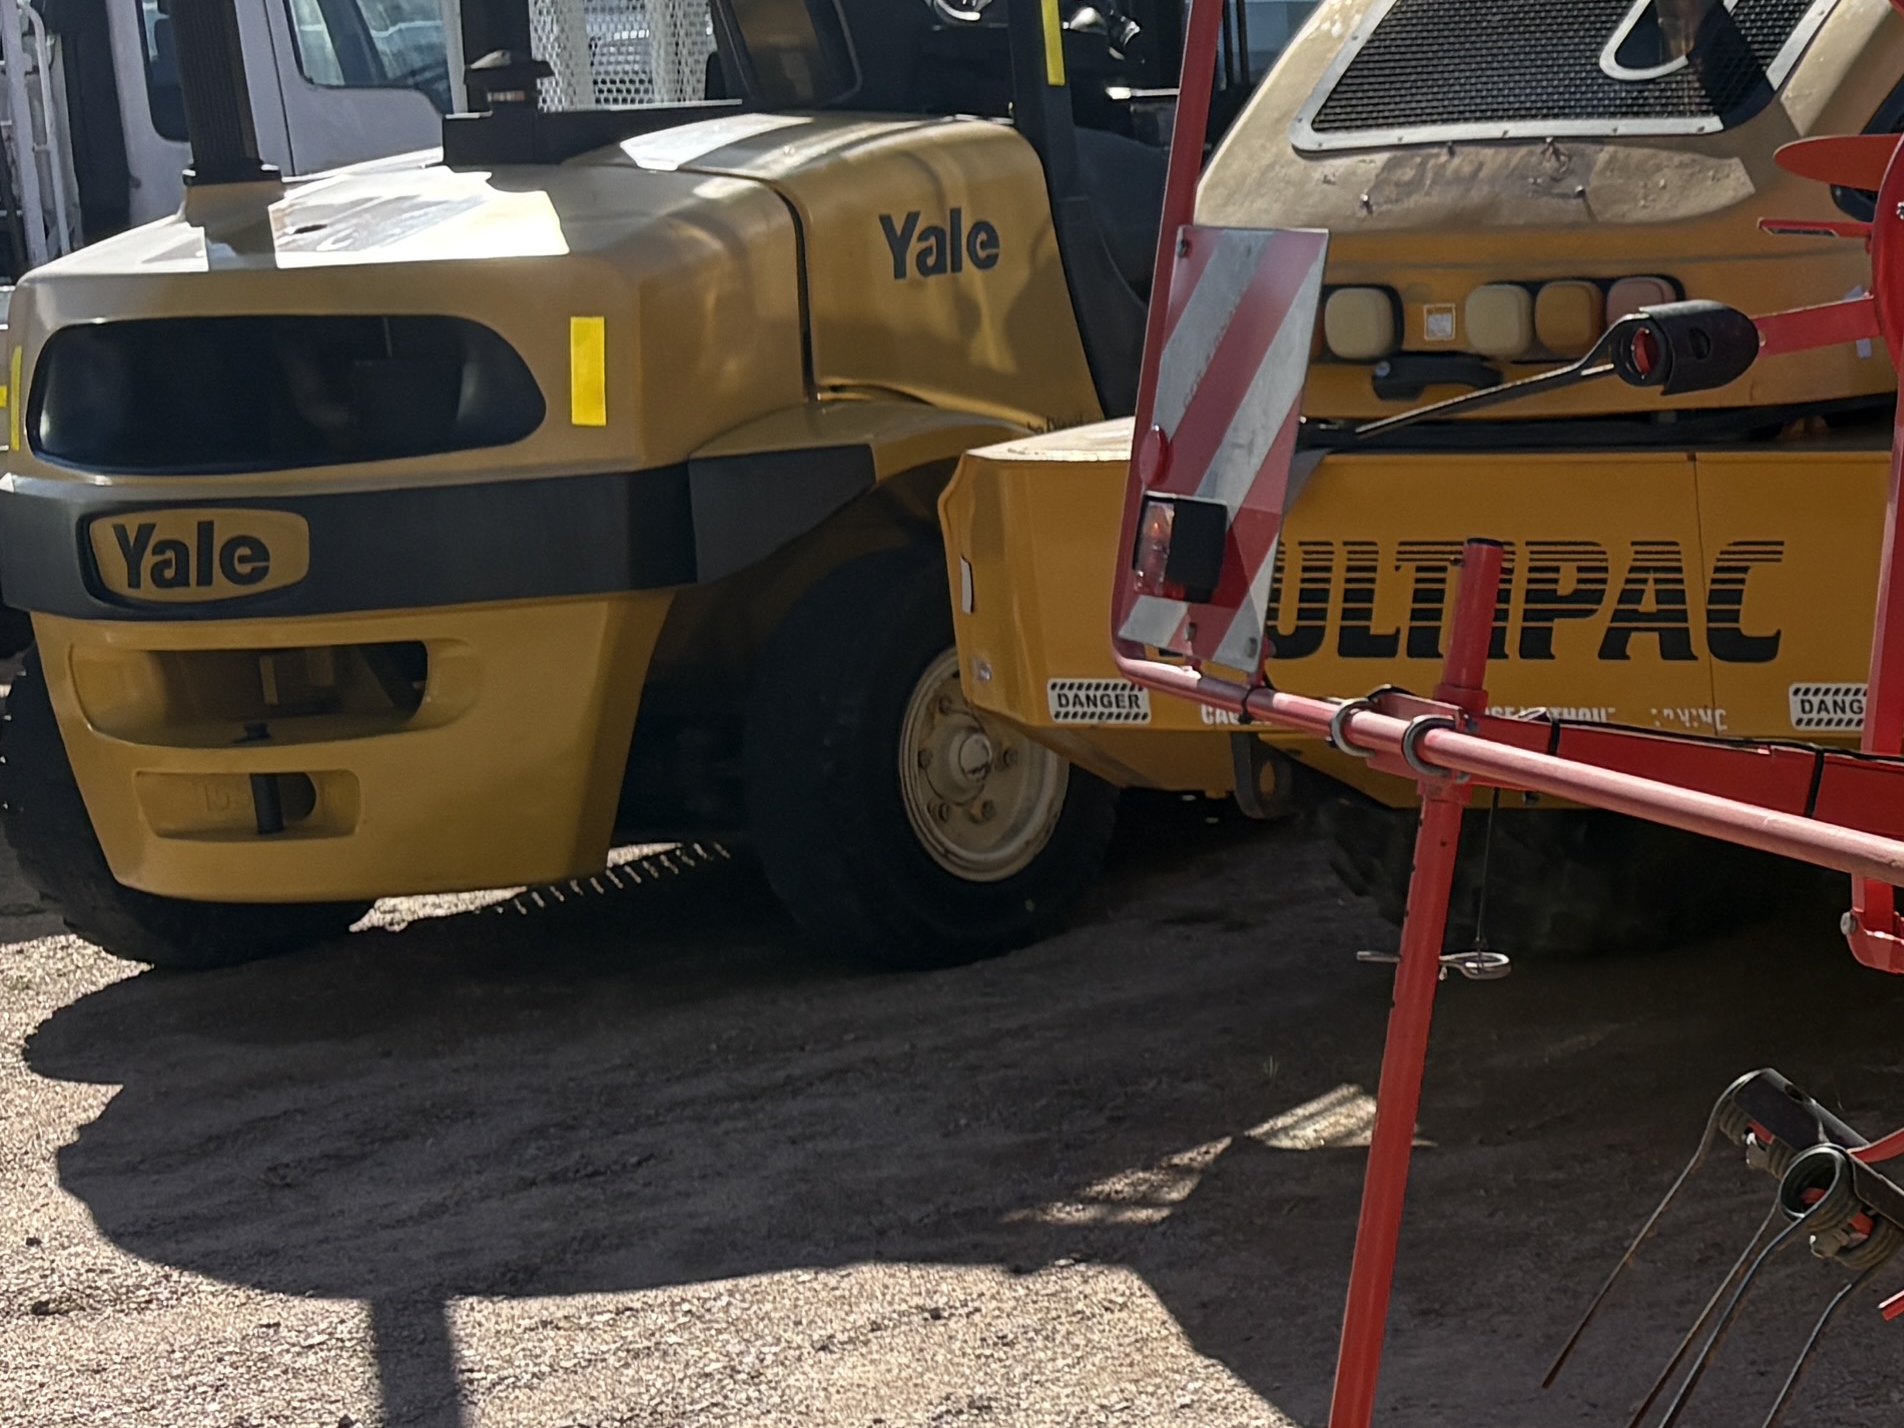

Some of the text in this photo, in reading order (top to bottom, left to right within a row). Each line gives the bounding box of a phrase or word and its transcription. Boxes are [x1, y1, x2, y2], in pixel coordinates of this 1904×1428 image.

[878, 205, 1001, 280] Yale
[111, 519, 271, 590] Yale
[1262, 539, 1785, 662] ULTIPAC
[1057, 692, 1141, 710] DANGER
